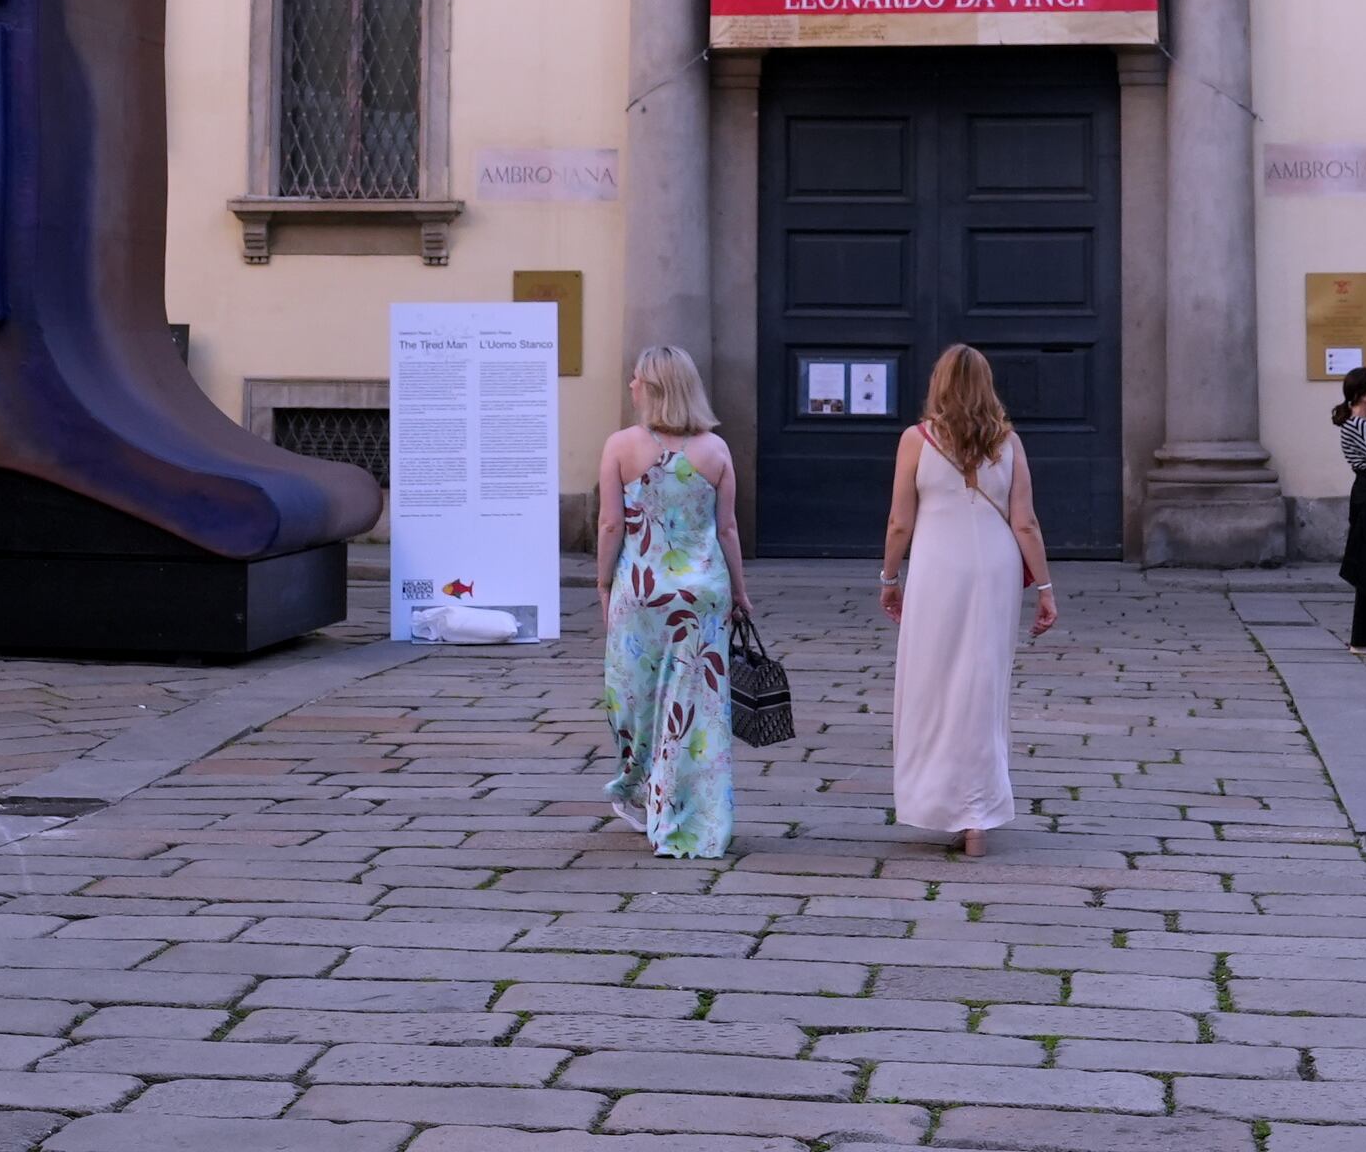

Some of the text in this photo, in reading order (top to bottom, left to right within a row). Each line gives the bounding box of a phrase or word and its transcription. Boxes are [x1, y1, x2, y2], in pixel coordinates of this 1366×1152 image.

[399, 340, 467, 350] The Tired Man
[479, 339, 554, 350] L'Uomo Stanco
